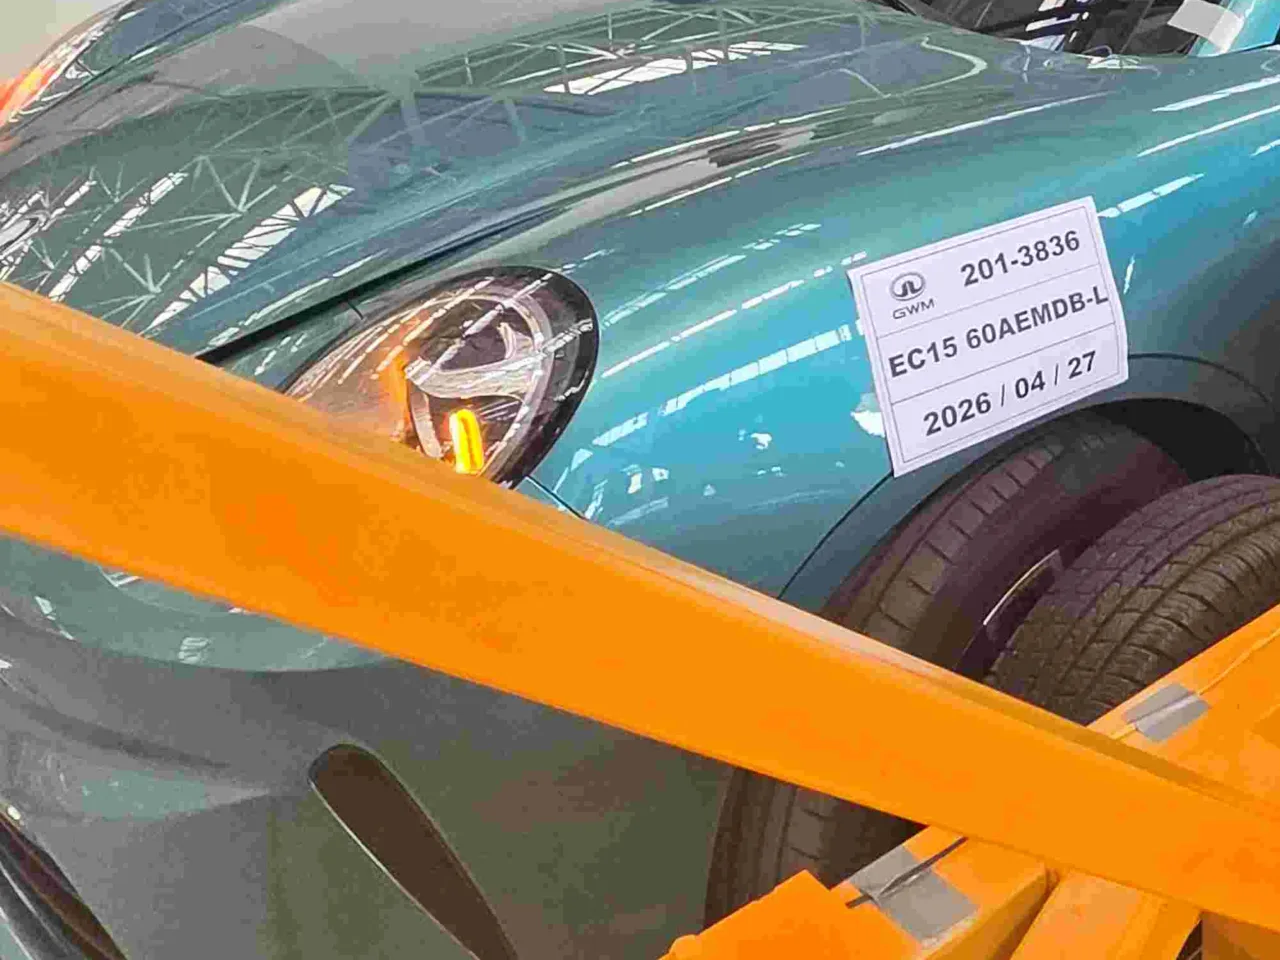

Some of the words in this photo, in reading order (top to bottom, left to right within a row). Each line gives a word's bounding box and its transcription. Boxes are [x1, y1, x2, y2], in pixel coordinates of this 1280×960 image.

[960, 230, 1080, 287] 201-3836
[888, 336, 958, 378] EC15
[966, 285, 1109, 349] 60AEMDB-L
[892, 298, 935, 320] GWM
[923, 392, 991, 436] 2026
[1014, 371, 1046, 399] 04
[1067, 351, 1097, 380] 27
